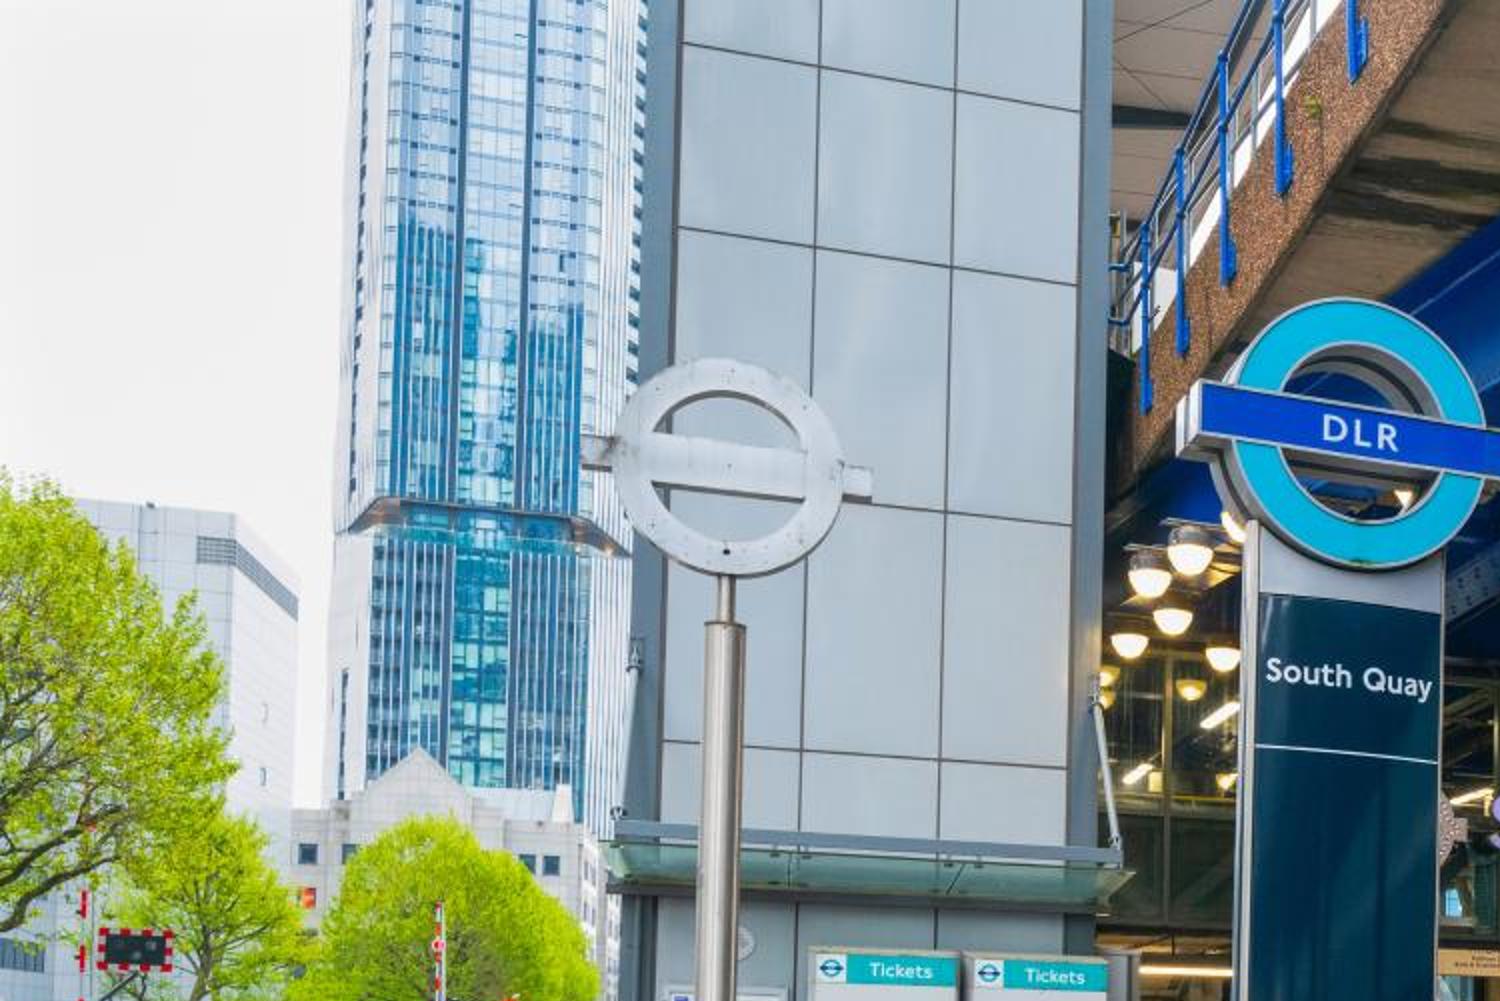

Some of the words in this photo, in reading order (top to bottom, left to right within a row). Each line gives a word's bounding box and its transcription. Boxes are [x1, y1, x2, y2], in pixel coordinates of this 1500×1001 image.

[1322, 413, 1399, 453] DLR
[1265, 657, 1353, 690] South
[1363, 666, 1433, 704] Quay
[868, 961, 934, 980] Tickets
[1025, 967, 1086, 985] Tickets
